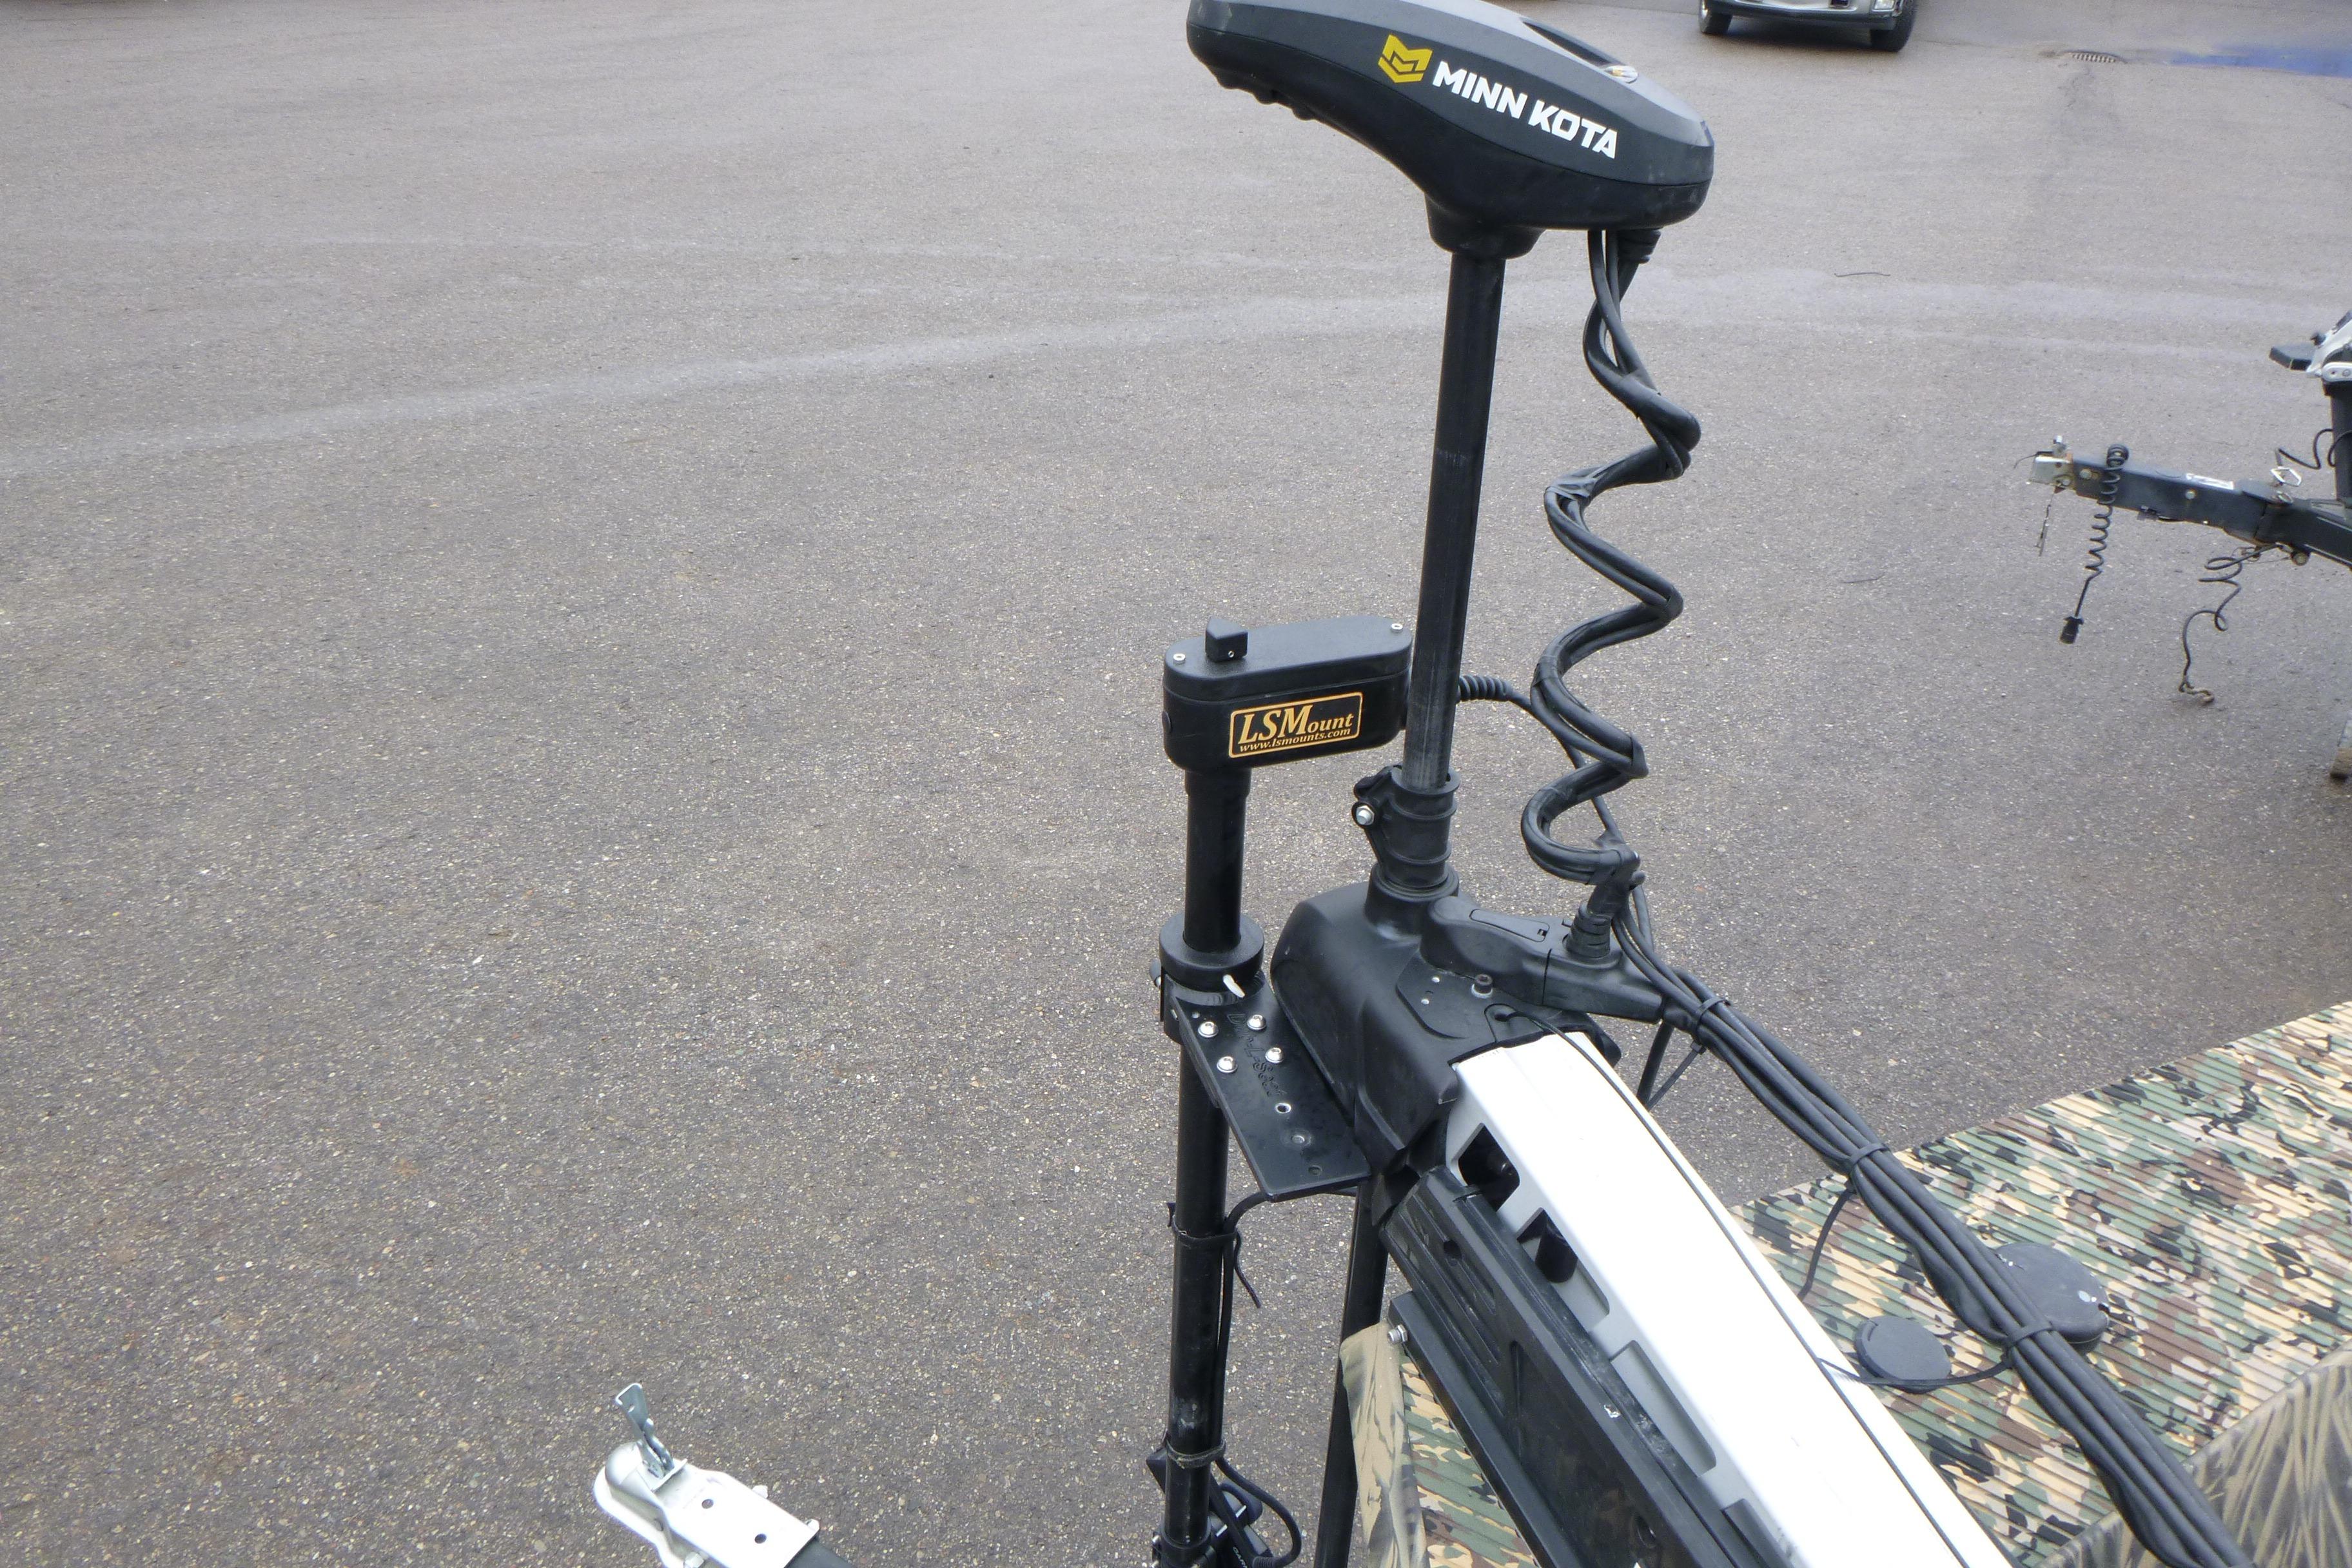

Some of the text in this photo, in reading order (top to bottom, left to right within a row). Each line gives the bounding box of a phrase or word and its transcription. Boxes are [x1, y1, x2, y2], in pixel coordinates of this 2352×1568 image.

[1432, 60, 1618, 159] MINN KOTA
[1237, 704, 1355, 745] LSMount
[1239, 728, 1351, 753] www.lsmounts.com
